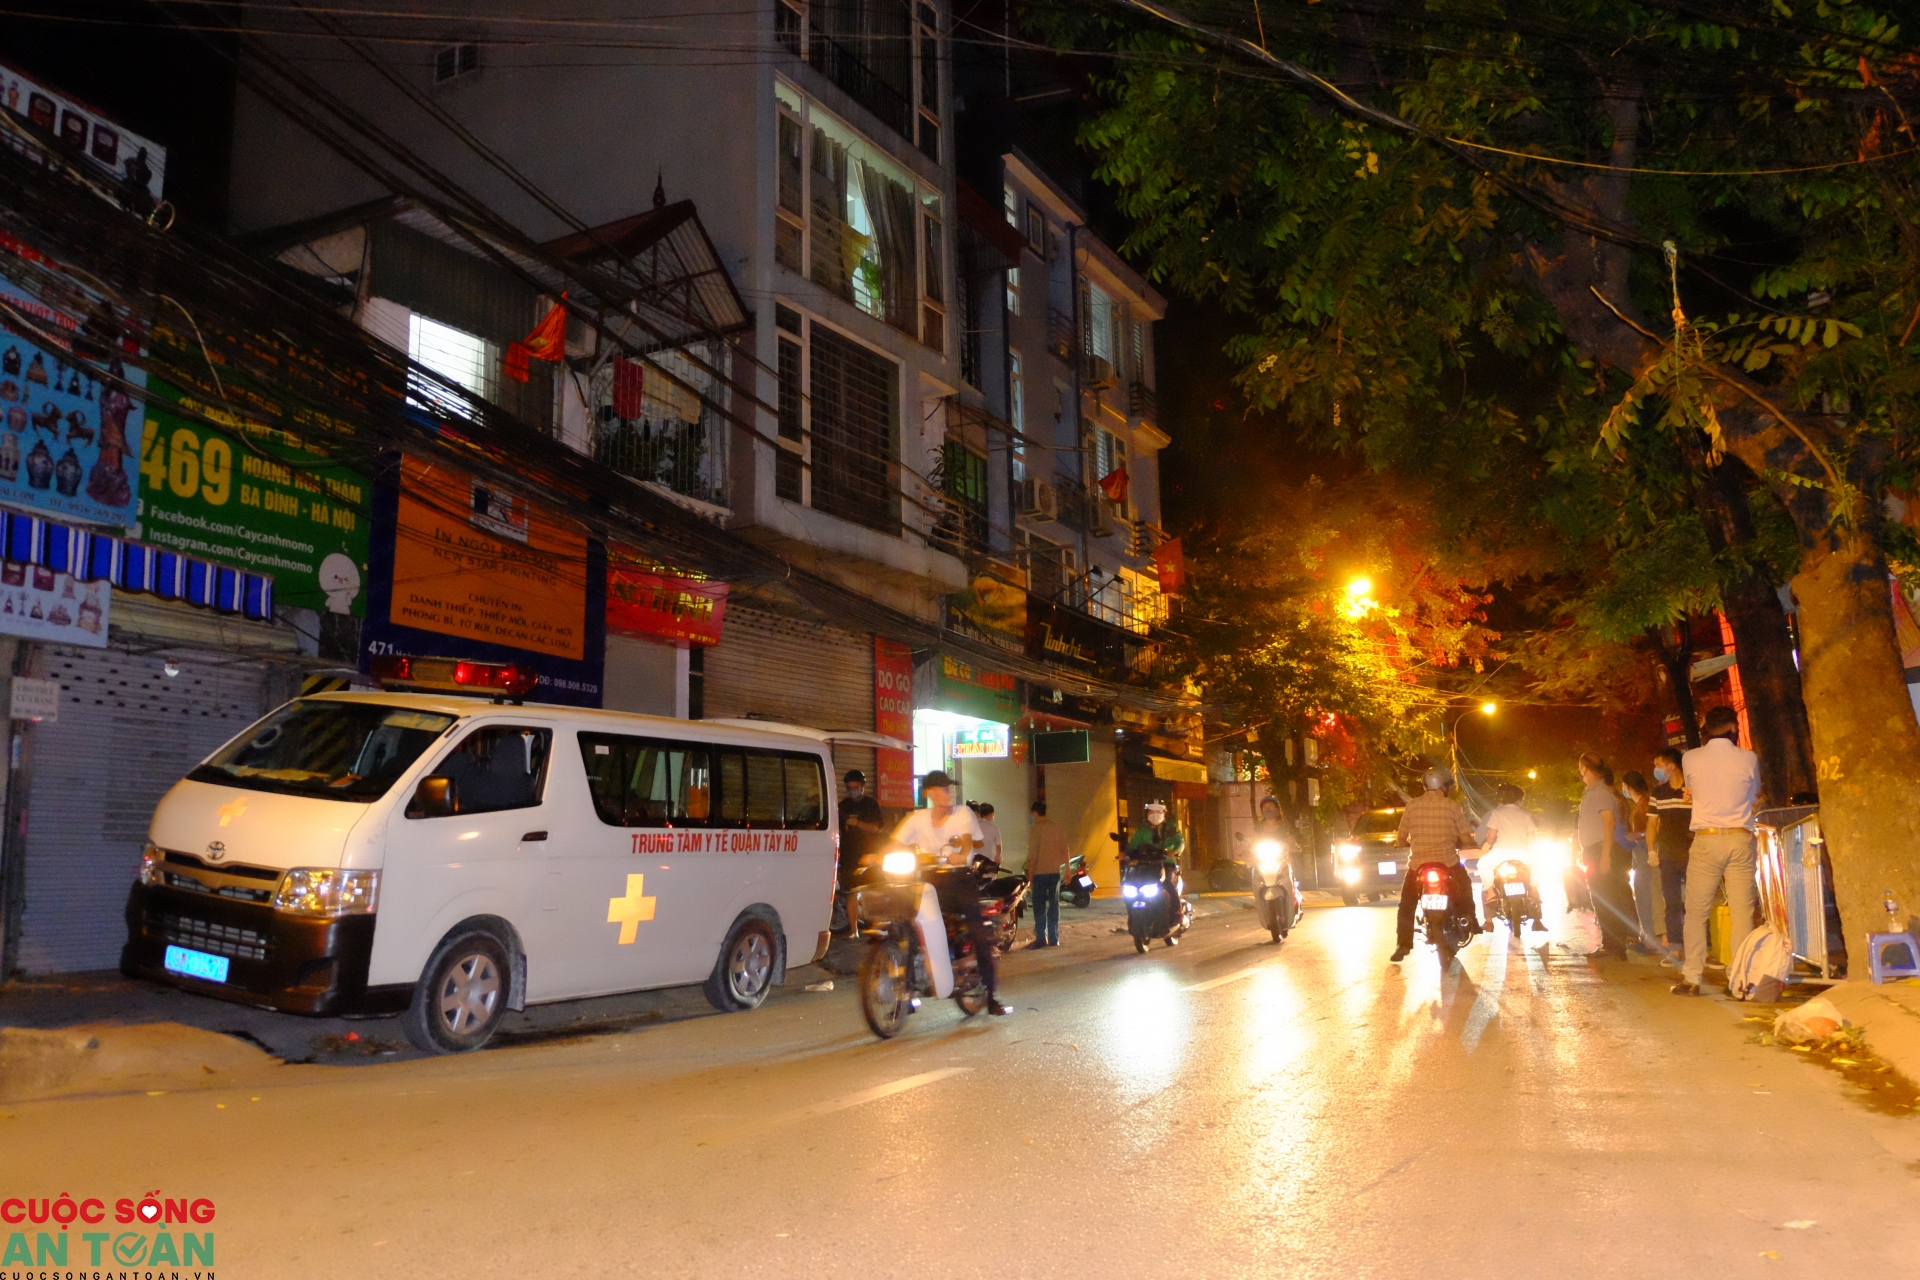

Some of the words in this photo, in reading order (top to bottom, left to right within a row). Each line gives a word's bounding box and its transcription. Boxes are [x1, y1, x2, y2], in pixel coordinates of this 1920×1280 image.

[139, 419, 232, 506] 469
[240, 484, 260, 508] BA
[264, 485, 298, 517] ĐÌNH
[311, 498, 329, 525] HÀ
[332, 506, 355, 534] NỘI
[150, 505, 314, 554] Facebook.com/Caycanhmomo
[434, 527, 452, 544] IN
[458, 533, 494, 554] NGÔI
[149, 528, 313, 574] Instagram.com/Caycanhmomo
[433, 546, 463, 561] NEW
[468, 556, 499, 572] STAR
[502, 564, 559, 587] PRINTING
[402, 607, 440, 624] PHONG
[409, 594, 442, 610] DANH
[368, 639, 394, 657] 471
[878, 666, 893, 690] ĐỒ
[879, 696, 895, 712] CAO
[632, 833, 674, 854] TRUNG
[677, 828, 703, 853] TÂM
[706, 833, 712, 853] Y
[715, 828, 730, 853] TẾ
[731, 828, 761, 855] QUẬN
[764, 828, 782, 852] TÂY
